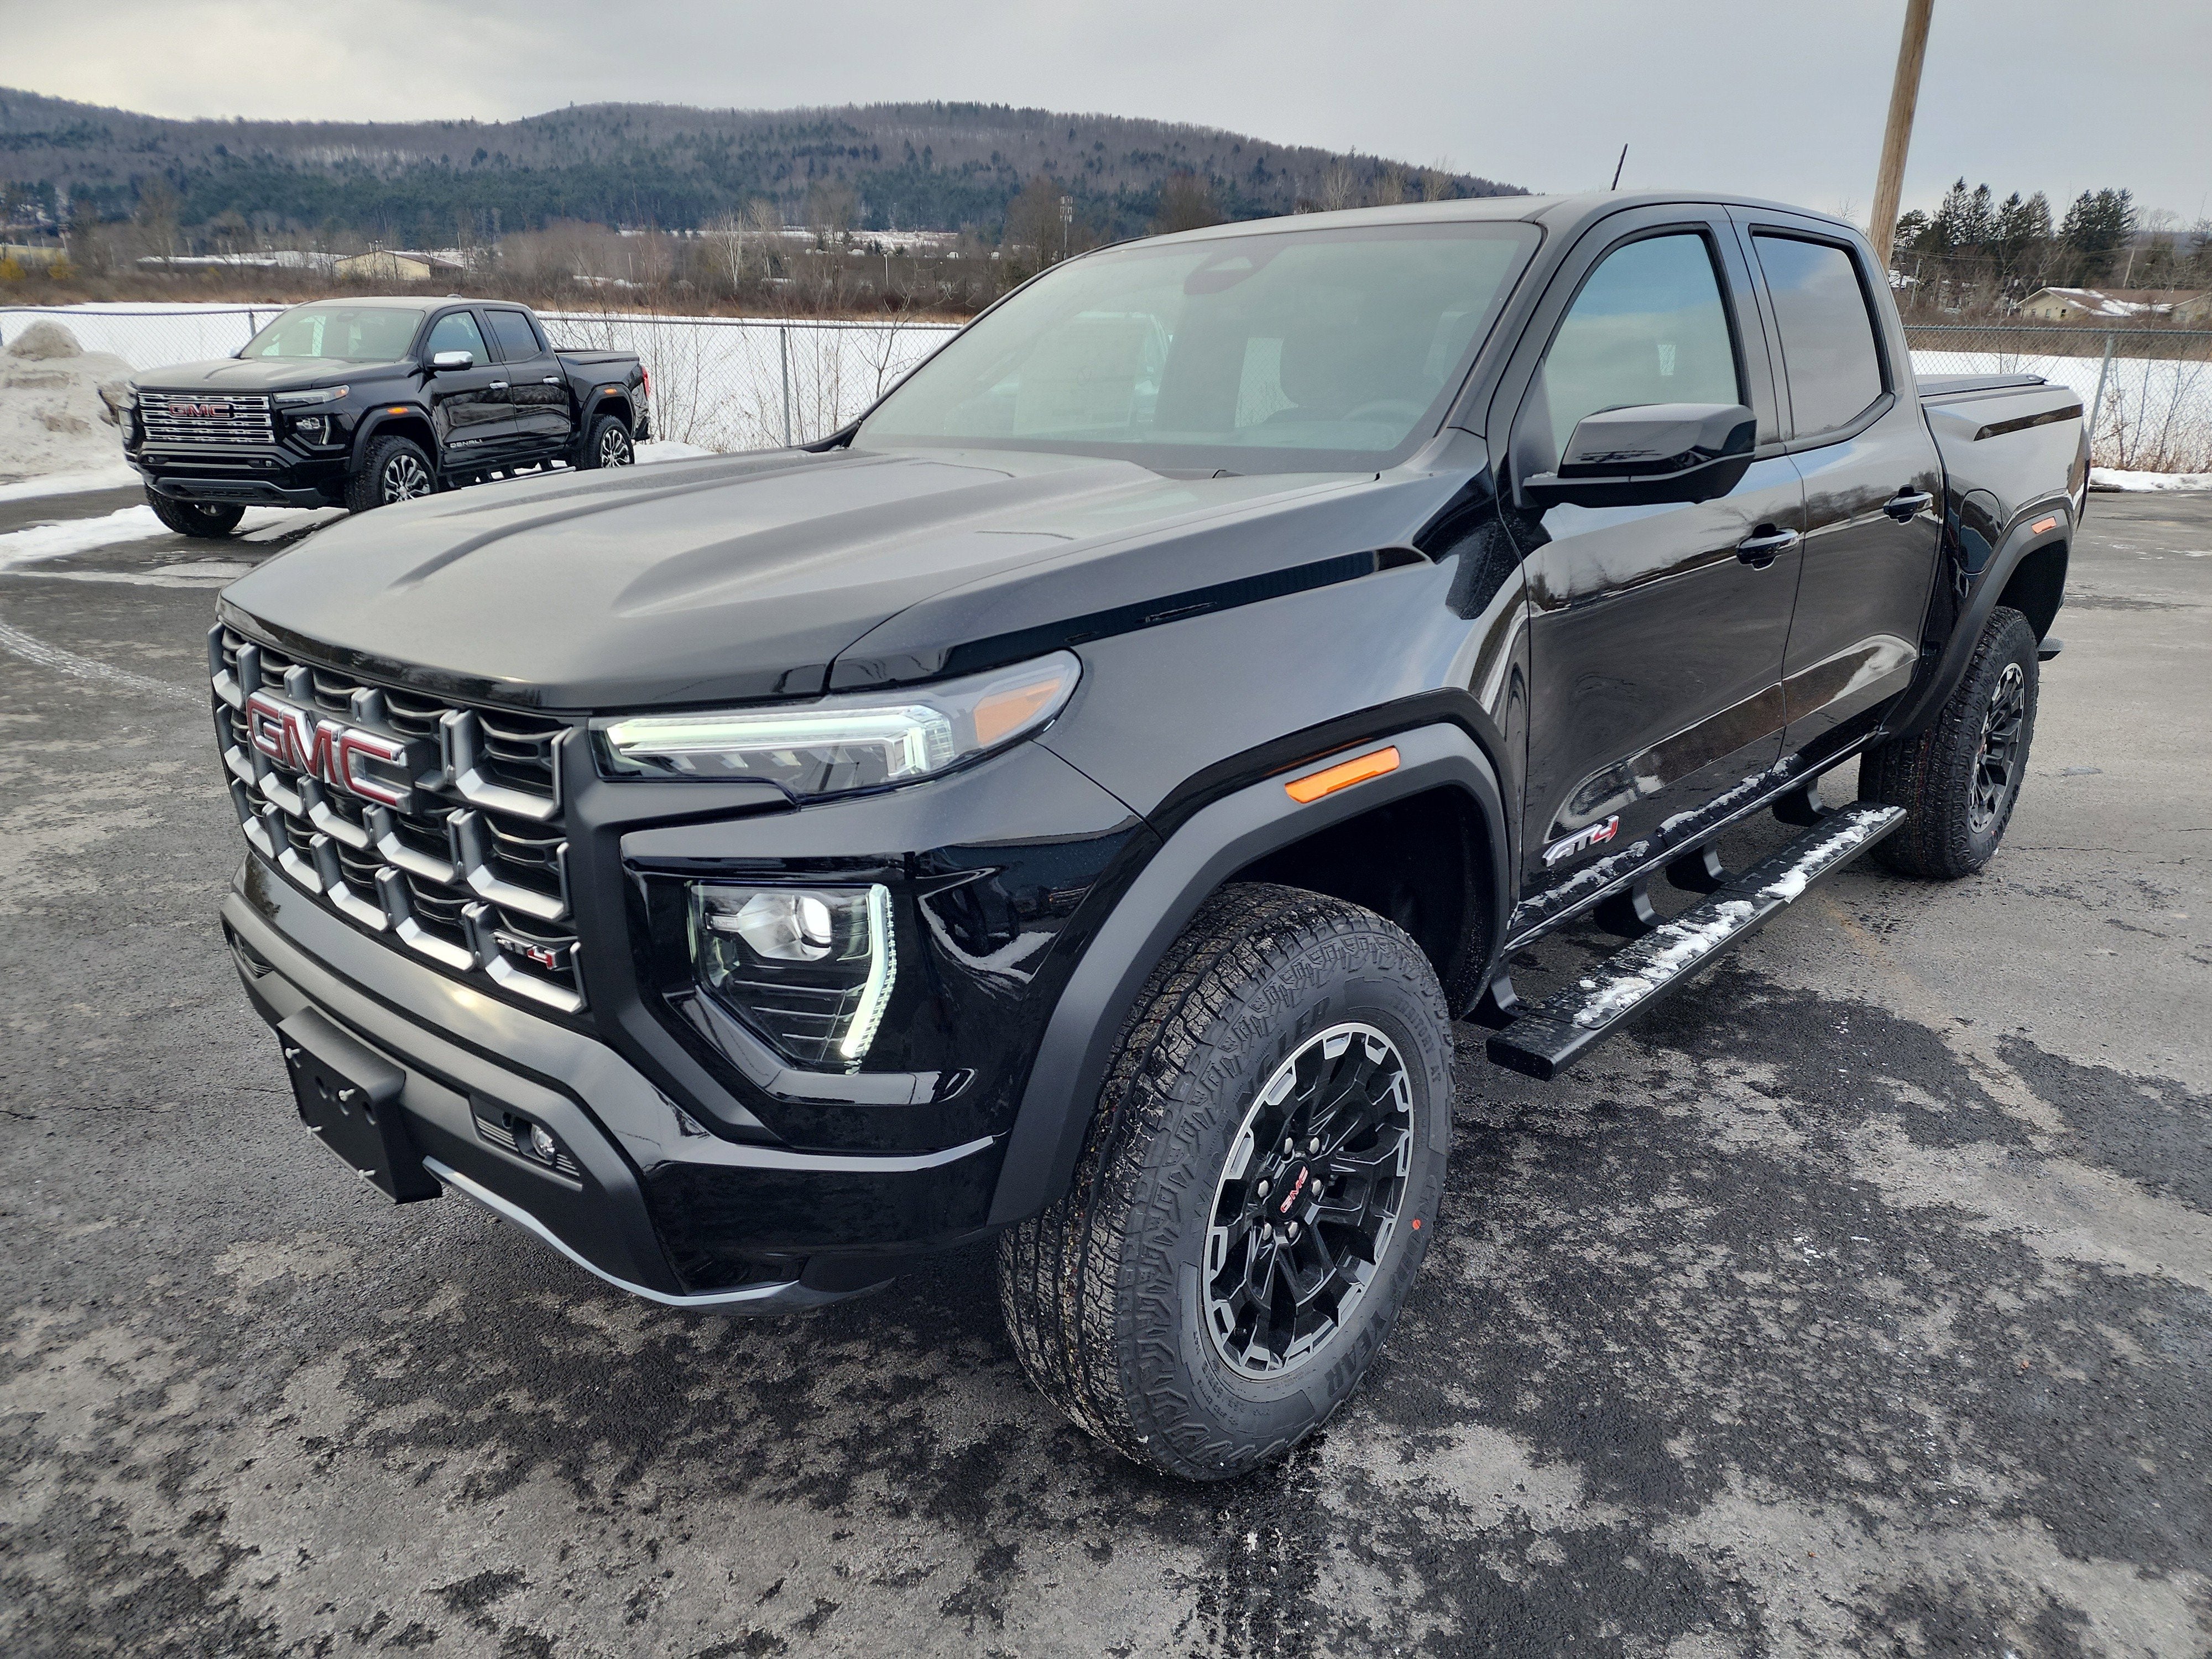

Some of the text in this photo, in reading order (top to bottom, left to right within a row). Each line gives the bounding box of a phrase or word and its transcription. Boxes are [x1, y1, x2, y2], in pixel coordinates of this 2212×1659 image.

[169, 403, 229, 418] GMC
[450, 439, 483, 448] DENALI
[247, 691, 411, 815] GMC
[1542, 815, 1620, 867] AT4
[493, 931, 557, 970] AT4
[1189, 997, 1331, 1236] WRANGLER
[1280, 1166, 1308, 1213] GMC
